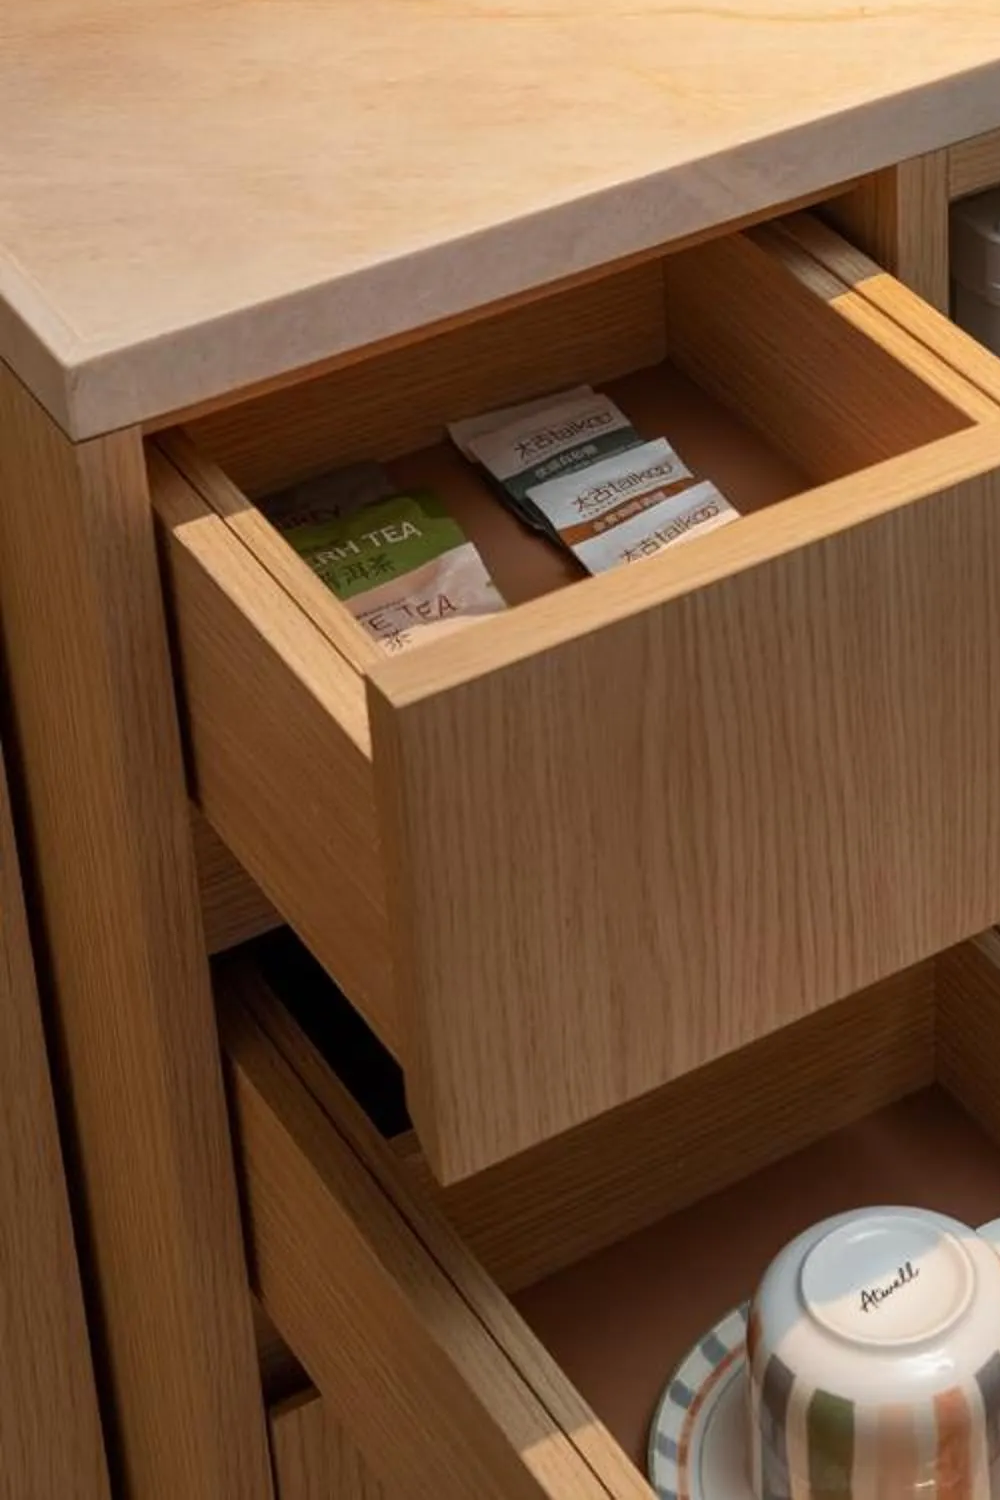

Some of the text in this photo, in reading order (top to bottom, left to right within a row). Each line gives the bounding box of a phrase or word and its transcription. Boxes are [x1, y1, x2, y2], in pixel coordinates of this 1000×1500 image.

[316, 520, 423, 568] RH TEA
[397, 593, 457, 620] TEA
[859, 1260, 921, 1313] Atwell
